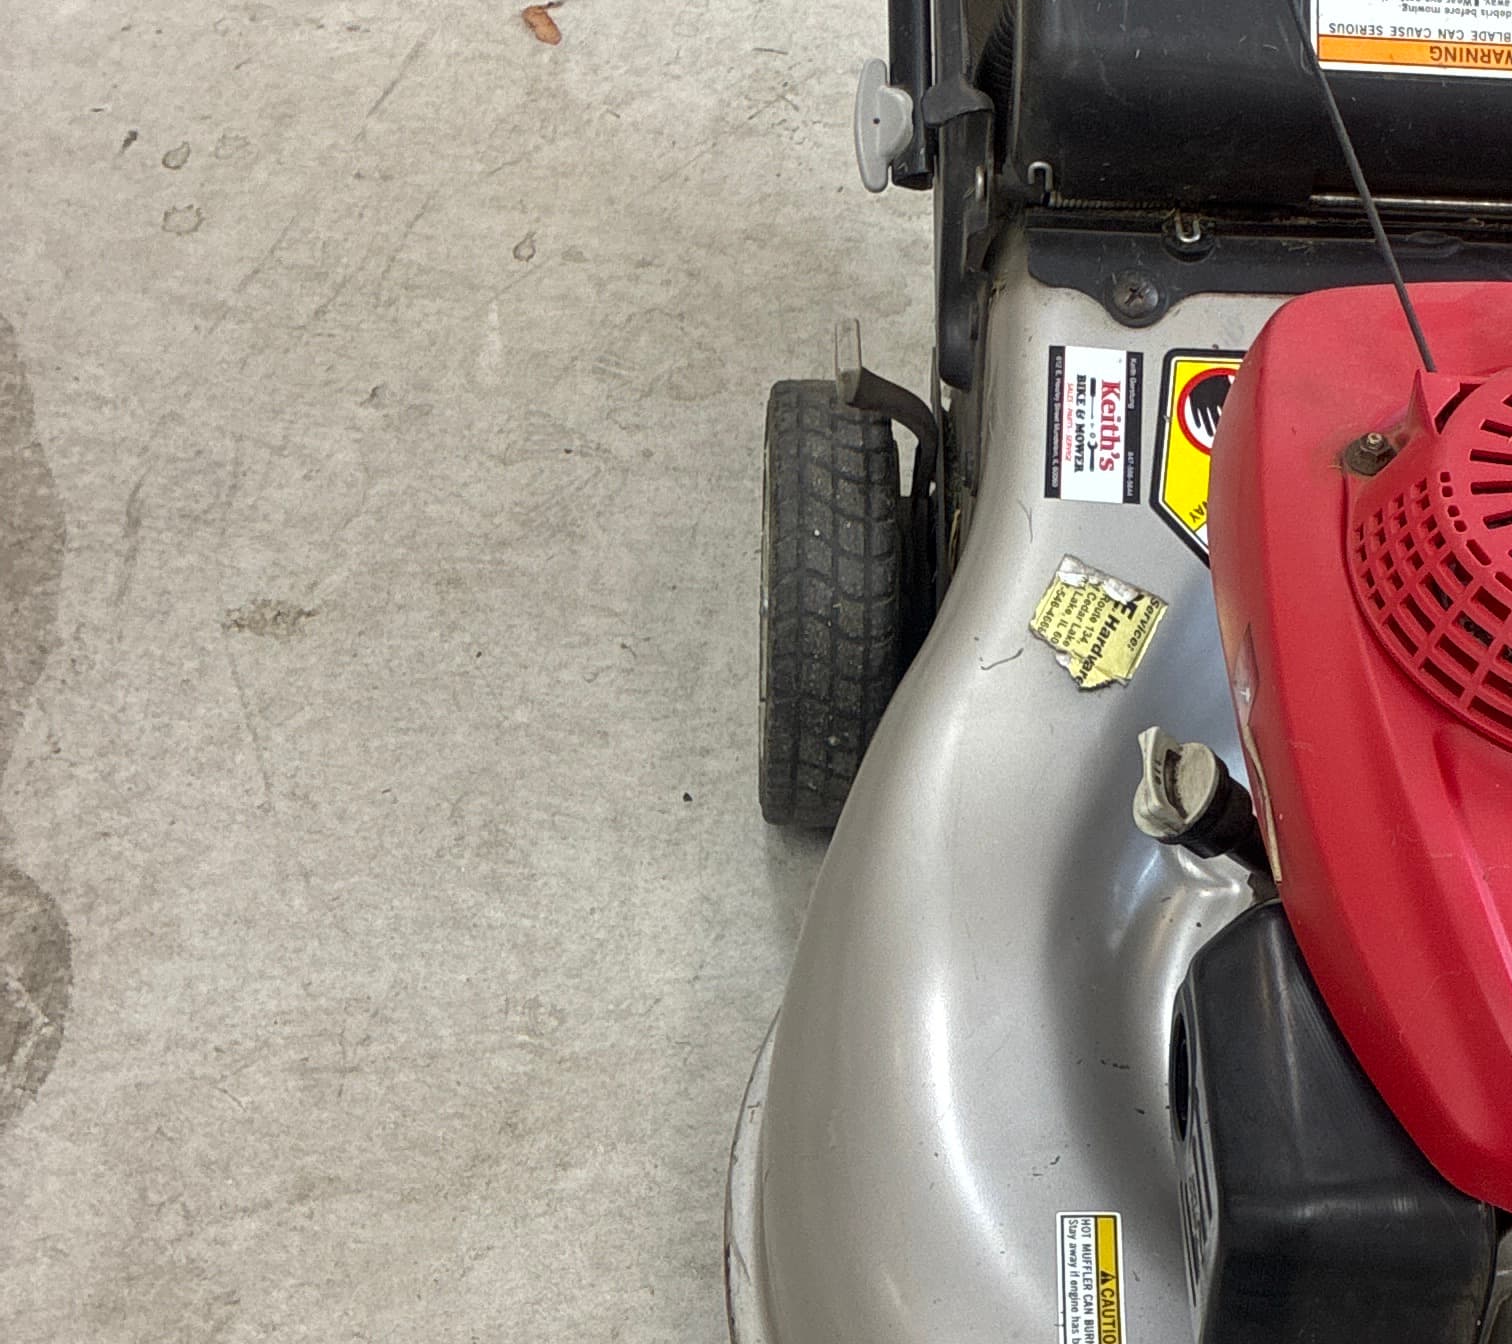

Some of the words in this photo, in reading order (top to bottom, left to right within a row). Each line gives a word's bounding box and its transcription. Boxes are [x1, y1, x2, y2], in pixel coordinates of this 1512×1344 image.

[1445, 7, 1477, 18] before
[1482, 9, 1512, 20] debris
[1329, 23, 1383, 36] SERIOUS
[1391, 26, 1432, 38] CAUSE
[1439, 29, 1464, 40] CAN
[1472, 31, 1511, 43] BLADE
[1075, 374, 1086, 406] BIKE
[1075, 409, 1085, 419] &
[1098, 379, 1121, 472] Keith's
[1074, 423, 1085, 472] MOWER
[1074, 593, 1096, 623] Cedar
[1056, 619, 1068, 629] IL
[1127, 598, 1159, 653] Service:
[1062, 623, 1080, 647] Lake
[1066, 1219, 1078, 1239] Stay
[1080, 1218, 1091, 1237] HOT
[1067, 1243, 1077, 1267] away
[1081, 1243, 1093, 1290] MUFFLER
[1068, 1280, 1080, 1312] engine
[1083, 1294, 1093, 1314] CAN
[1071, 1316, 1081, 1333] has
